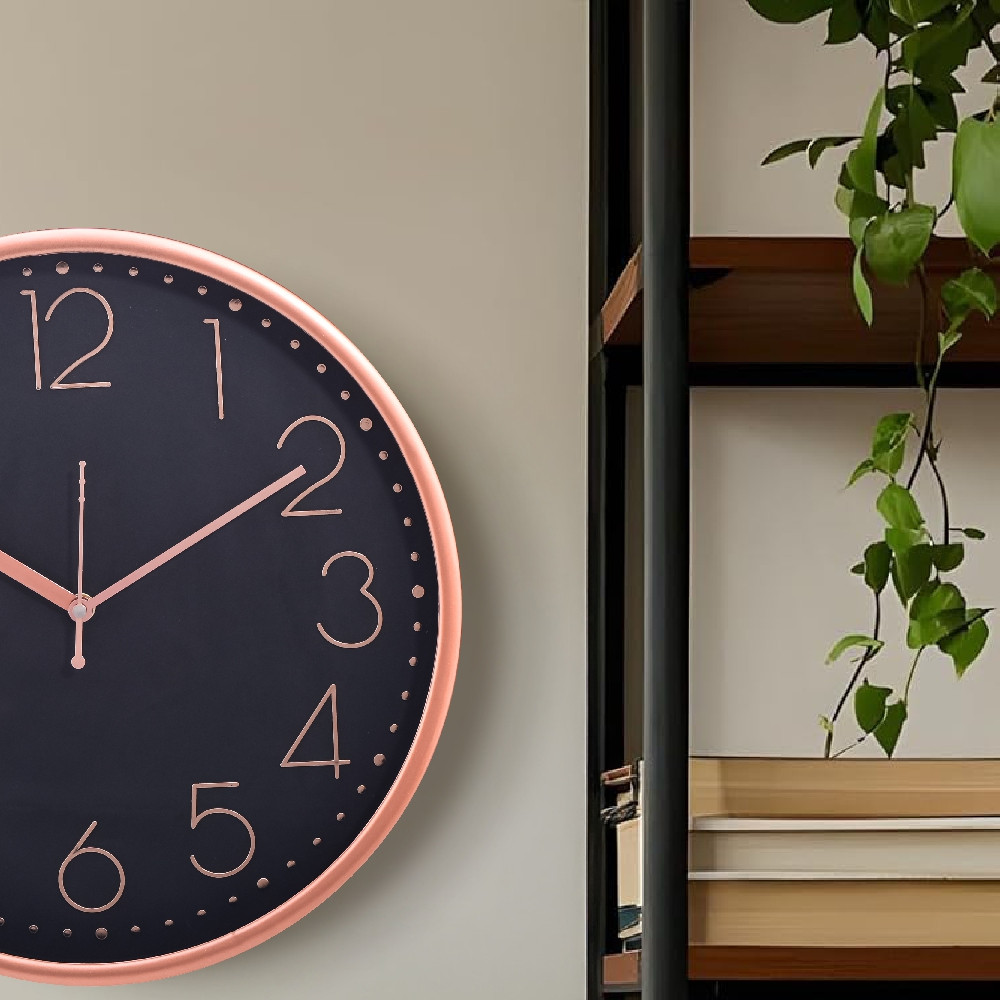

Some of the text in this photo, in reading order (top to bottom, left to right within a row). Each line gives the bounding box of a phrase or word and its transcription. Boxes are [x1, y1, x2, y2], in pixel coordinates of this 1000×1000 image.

[21, 287, 114, 390] 12
[204, 318, 225, 420] 1
[276, 415, 346, 517] 2
[317, 551, 384, 649] 3
[280, 684, 352, 779] 4
[58, 821, 126, 913] 6
[190, 782, 256, 878] 5
